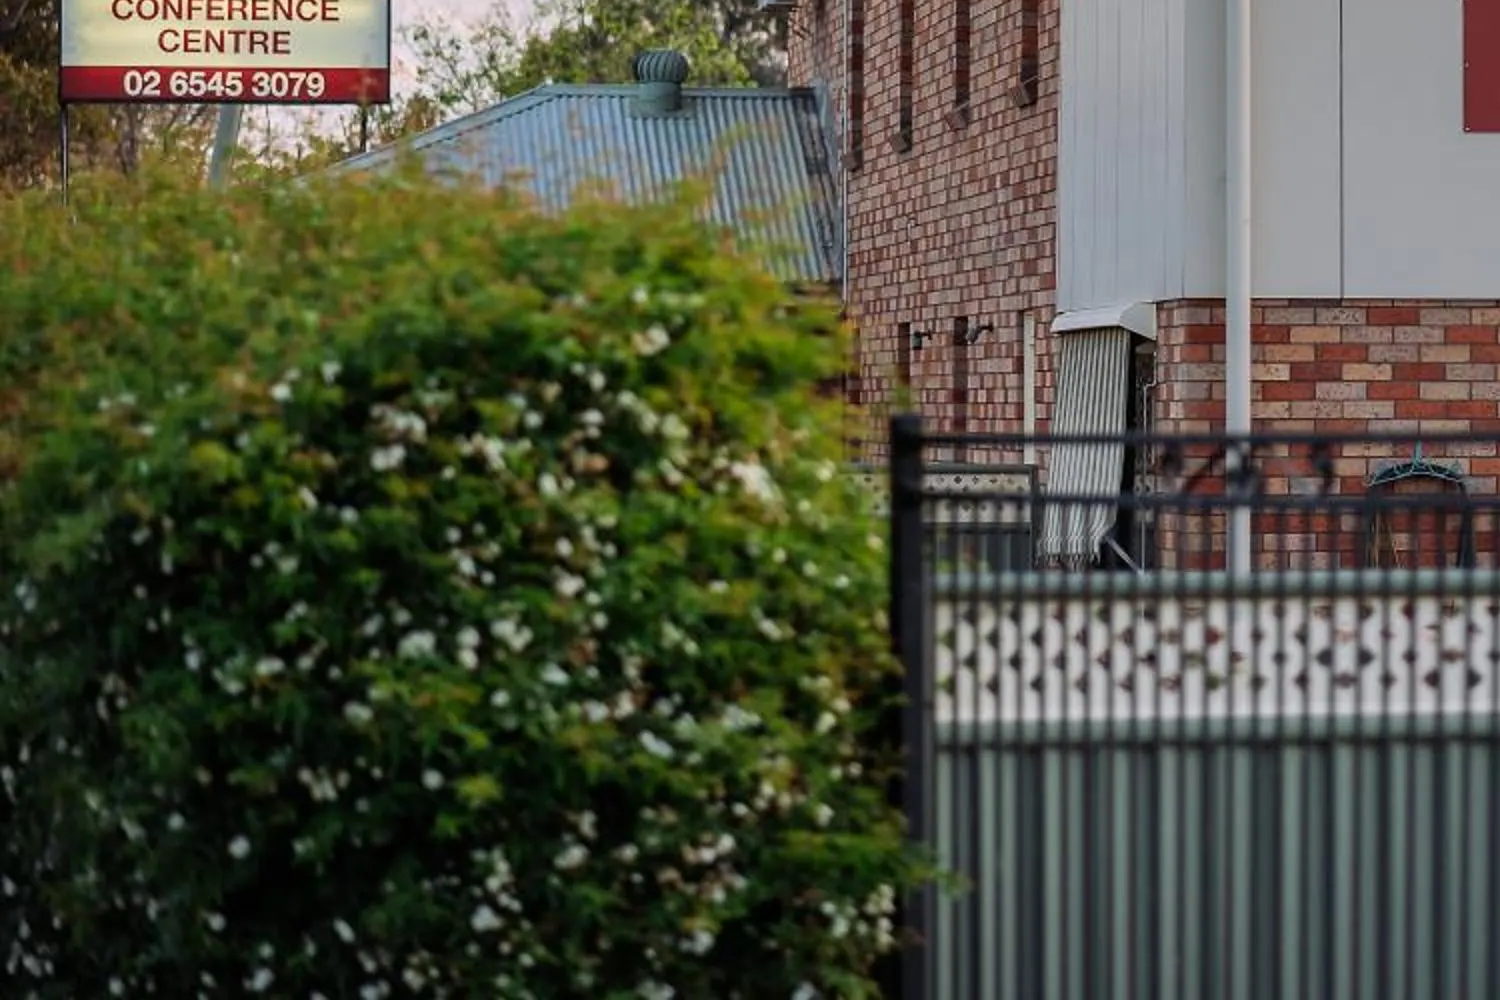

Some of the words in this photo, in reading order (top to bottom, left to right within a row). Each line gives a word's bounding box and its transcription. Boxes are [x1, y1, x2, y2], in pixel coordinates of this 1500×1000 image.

[158, 28, 292, 55] CENTRE
[123, 70, 161, 97] 02
[169, 70, 243, 97] 6545
[251, 70, 326, 97] 3079
